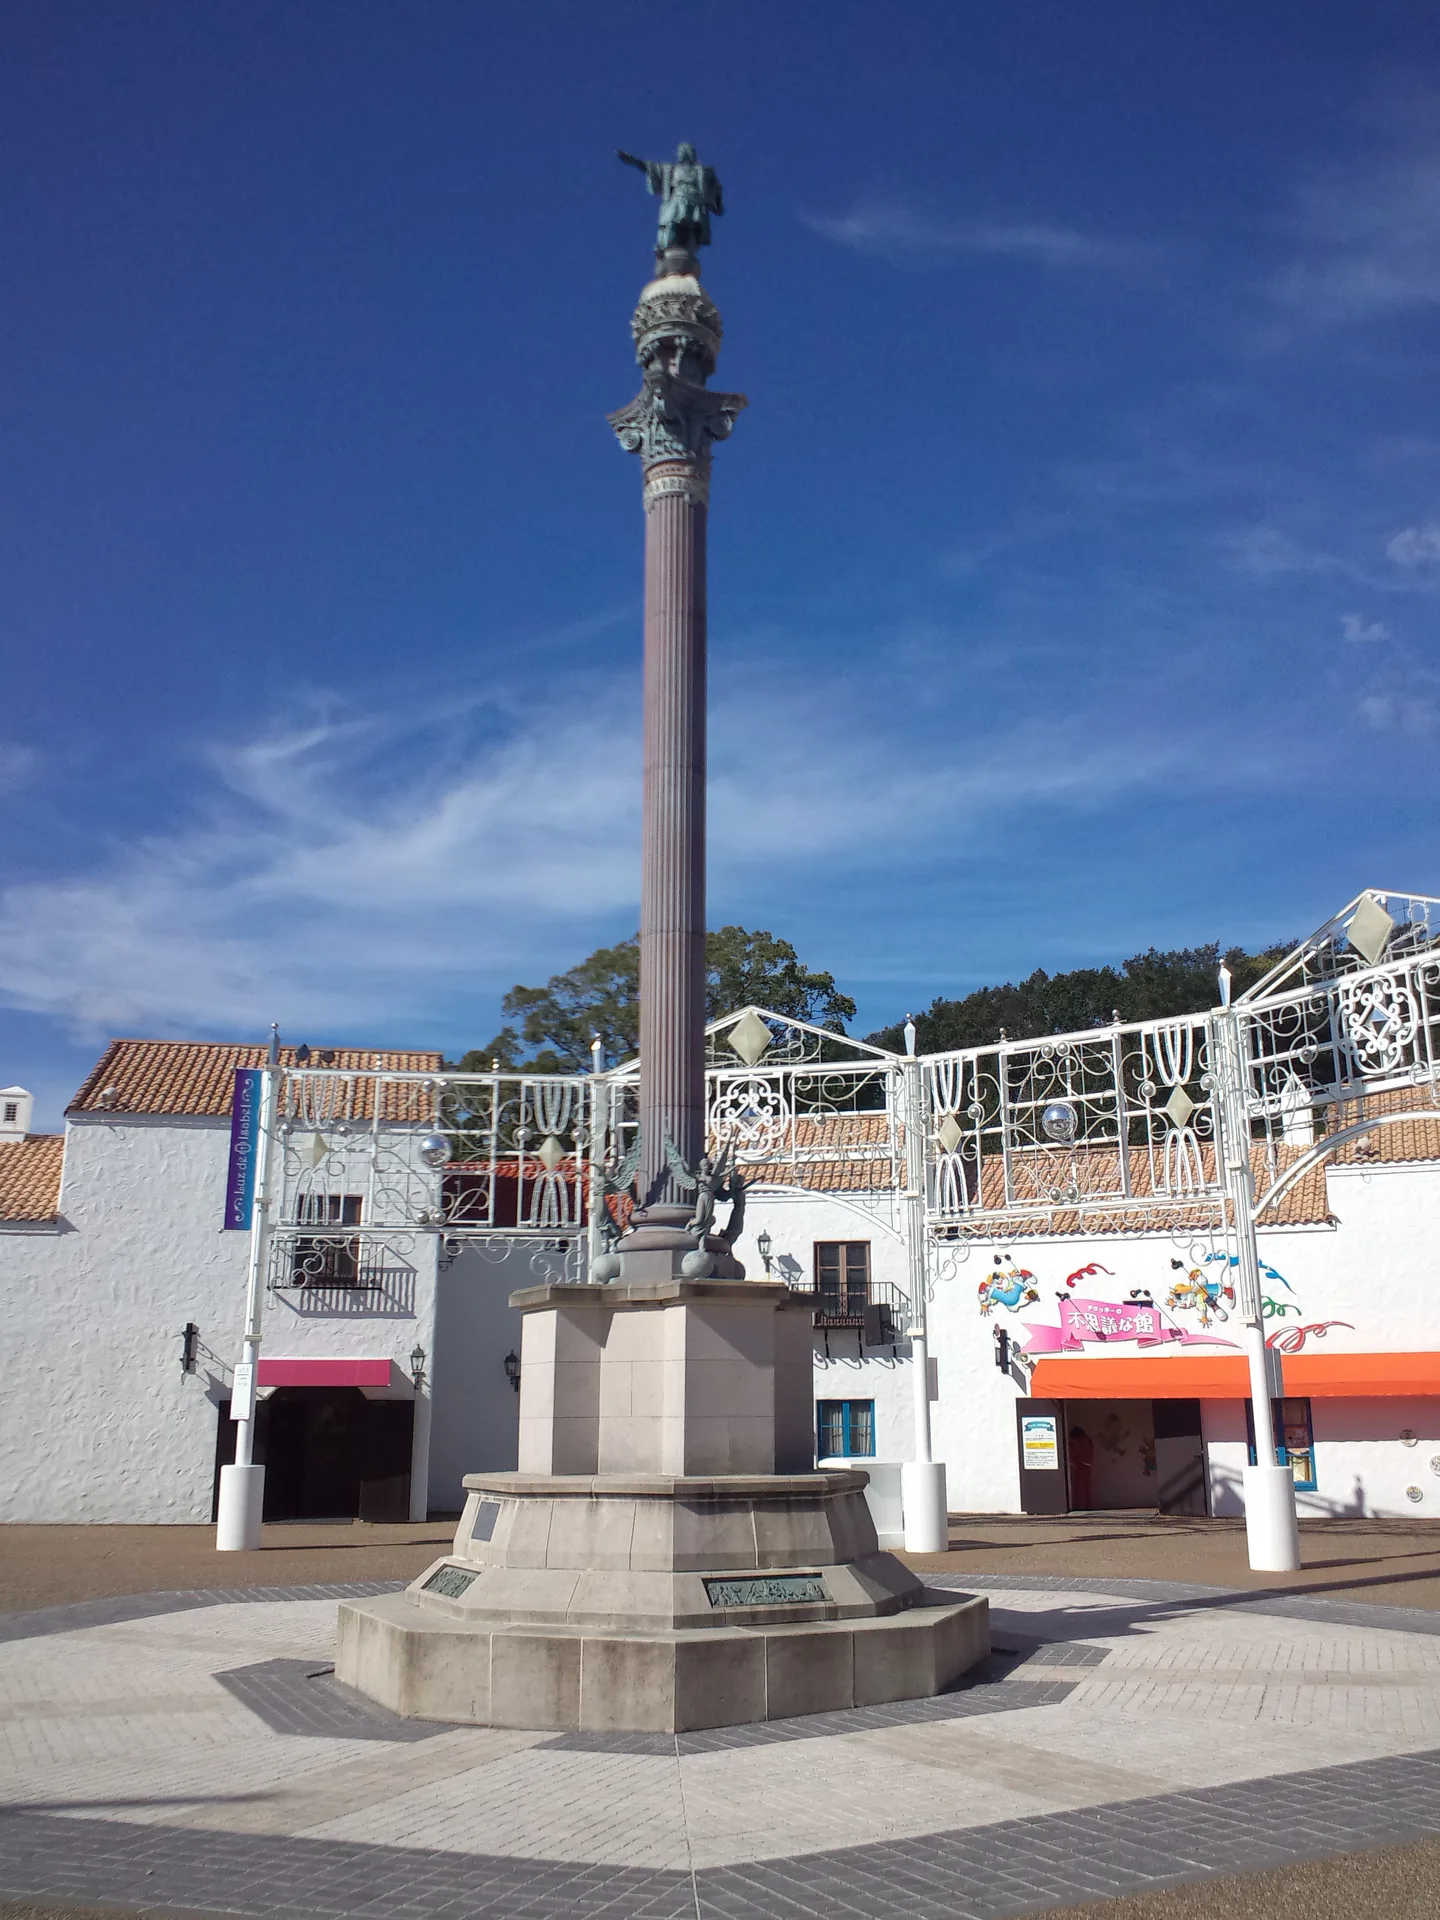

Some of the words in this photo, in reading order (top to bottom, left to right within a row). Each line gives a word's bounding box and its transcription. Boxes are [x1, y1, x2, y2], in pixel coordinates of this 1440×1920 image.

[238, 1104, 252, 1140] Isabel
[236, 1153, 248, 1171] de
[1087, 1304, 1123, 1315] チョッキーの
[1067, 1312, 1154, 1335] 不思議な館
